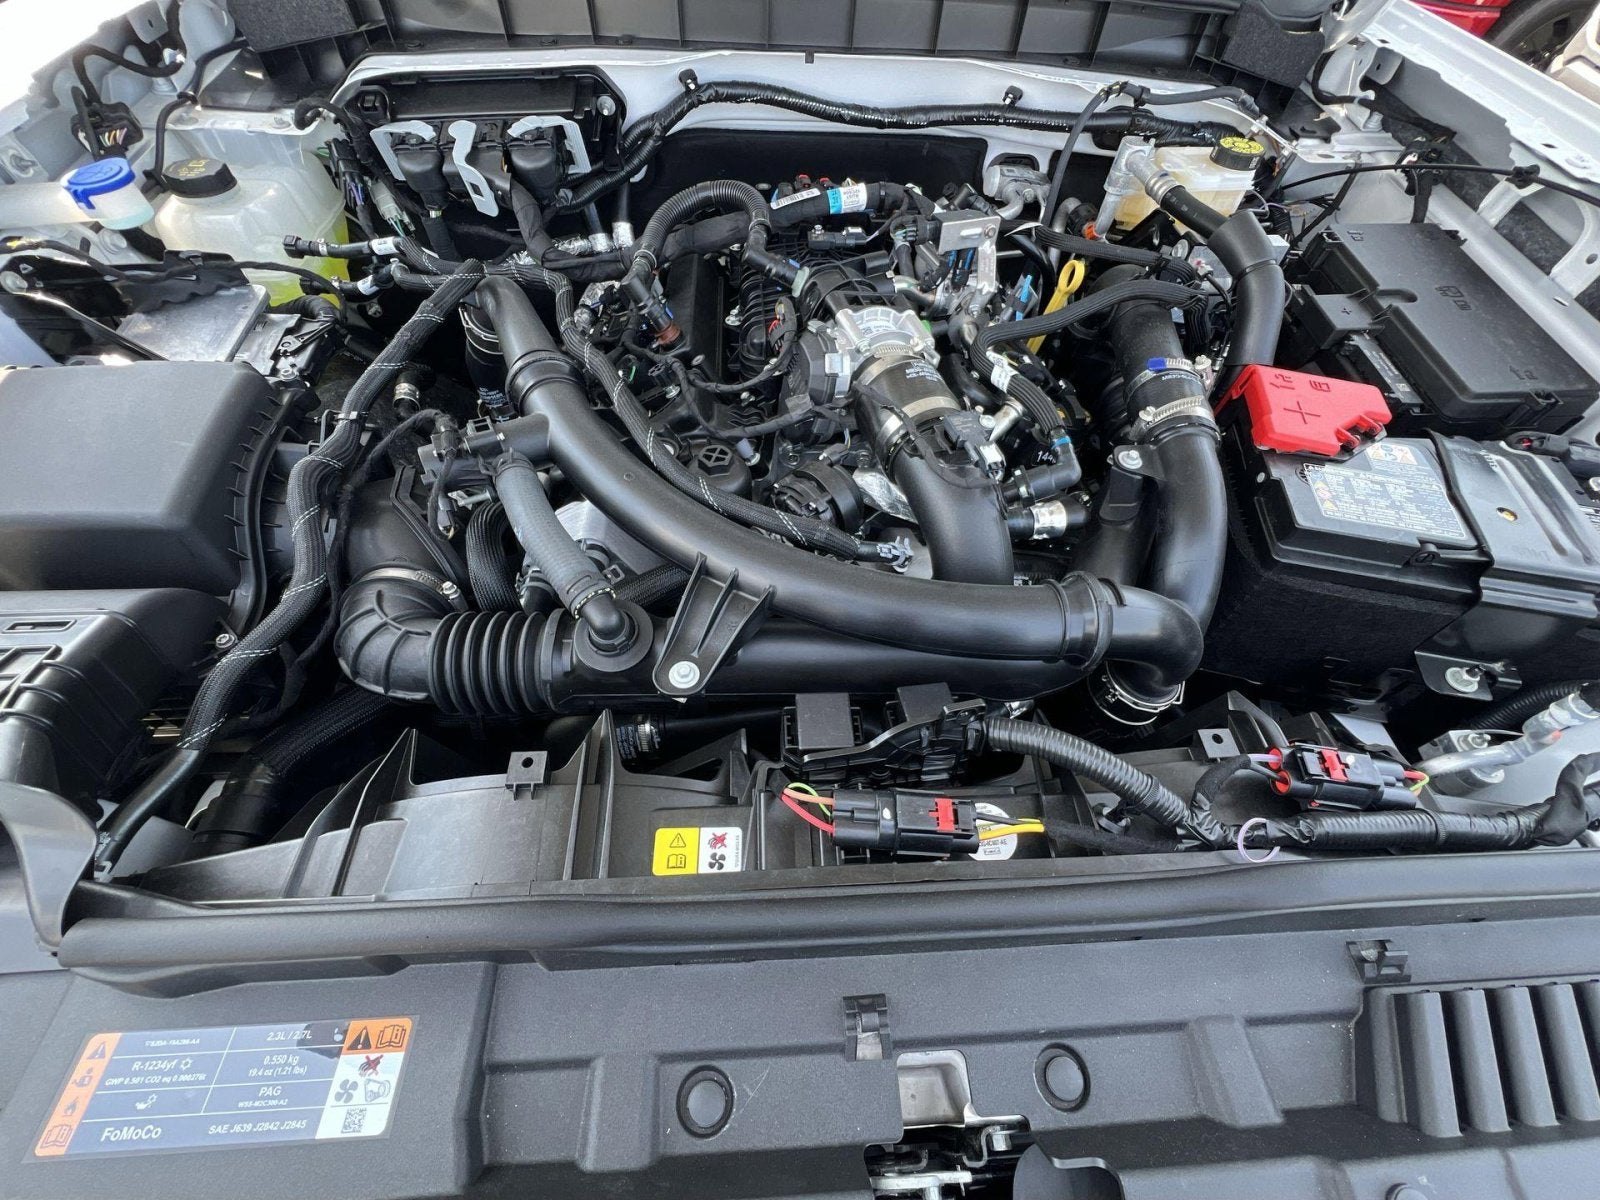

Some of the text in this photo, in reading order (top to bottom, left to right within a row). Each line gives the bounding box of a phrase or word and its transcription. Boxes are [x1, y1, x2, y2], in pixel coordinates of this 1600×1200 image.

[267, 1032, 286, 1041] 2.3L
[292, 1030, 313, 1040] 2.7L
[264, 1054, 300, 1065] 0.550 kg
[132, 1061, 178, 1071] R-1234yf
[248, 1068, 263, 1077] 19.4
[273, 1066, 292, 1077] (1.21
[292, 1065, 308, 1076] lbs)
[105, 1078, 125, 1086] GWP
[145, 1075, 162, 1084] CO2
[259, 1086, 283, 1096] PAG
[208, 1120, 307, 1135] SAE J639 J2842 J2845
[100, 1125, 162, 1142] FoMoCo
